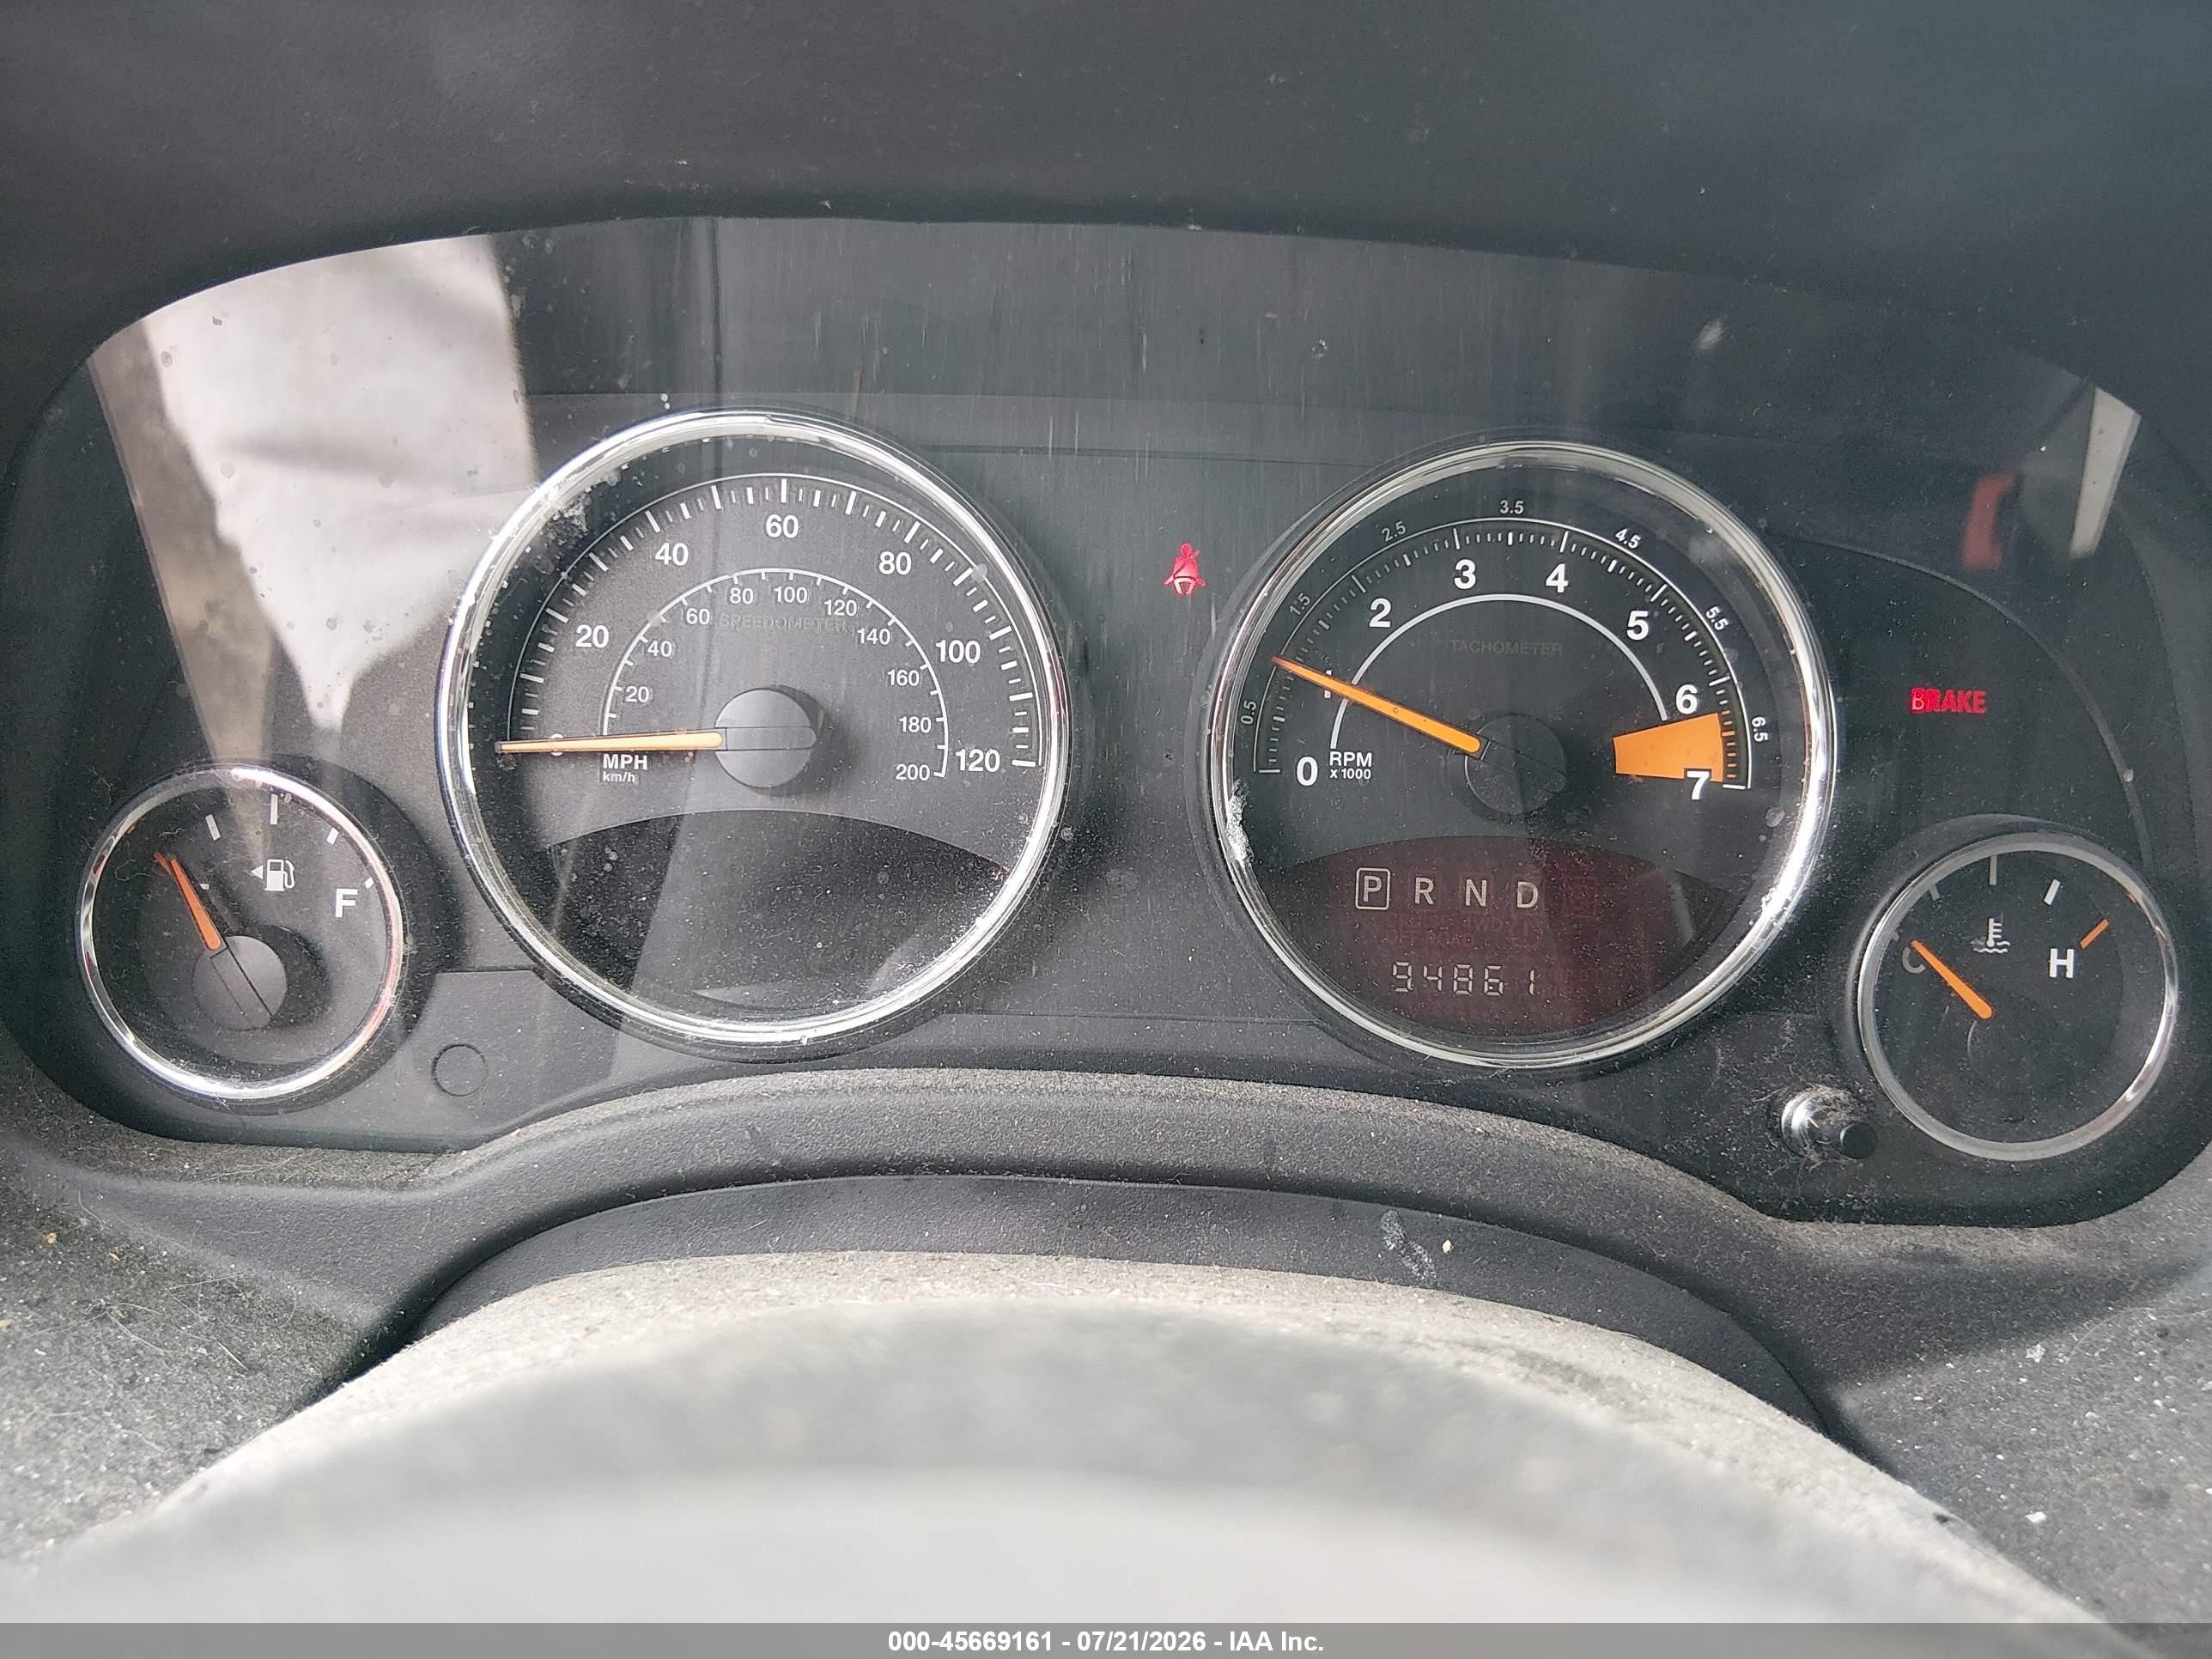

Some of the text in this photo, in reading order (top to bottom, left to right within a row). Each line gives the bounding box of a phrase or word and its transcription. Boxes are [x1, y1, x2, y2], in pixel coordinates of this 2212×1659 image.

[1500, 501, 1523, 514] 3.5
[766, 514, 799, 538] 60
[1382, 522, 1407, 543] 2.5
[1614, 529, 1641, 550] 4.5
[655, 543, 689, 565] 40
[879, 551, 911, 574] 80
[1455, 560, 1475, 589] 3
[1547, 564, 1568, 592] 4
[730, 587, 753, 605] 80
[775, 586, 807, 603] 100
[1289, 593, 1311, 616] 1.5
[687, 608, 710, 624] 60
[824, 599, 857, 616] 120
[1370, 599, 1390, 627] 2
[1705, 606, 1729, 632] 5.5
[576, 625, 609, 647] 20
[858, 628, 890, 645] 140
[1627, 611, 1649, 640] 5
[647, 640, 672, 657] 40
[936, 640, 980, 664] 100
[1449, 639, 1563, 656] TACHOMETER
[888, 669, 920, 686] 160
[626, 686, 652, 702] 20
[1676, 684, 1698, 714] 6
[1911, 688, 1985, 713] BRAKE
[899, 717, 931, 732] 180
[1241, 701, 1257, 725] 0.5
[1752, 717, 1768, 741] 6.5
[603, 754, 647, 771] MPH
[956, 749, 1000, 772] 120
[1330, 751, 1372, 767] RPM
[603, 772, 636, 784] km/h
[896, 764, 930, 781] 200
[1297, 757, 1317, 786] 0
[1686, 769, 1711, 800] 7
[336, 889, 357, 917] F
[1364, 876, 1538, 908] P R N D
[2050, 949, 2074, 978] H
[1393, 962, 1534, 995] 94861
